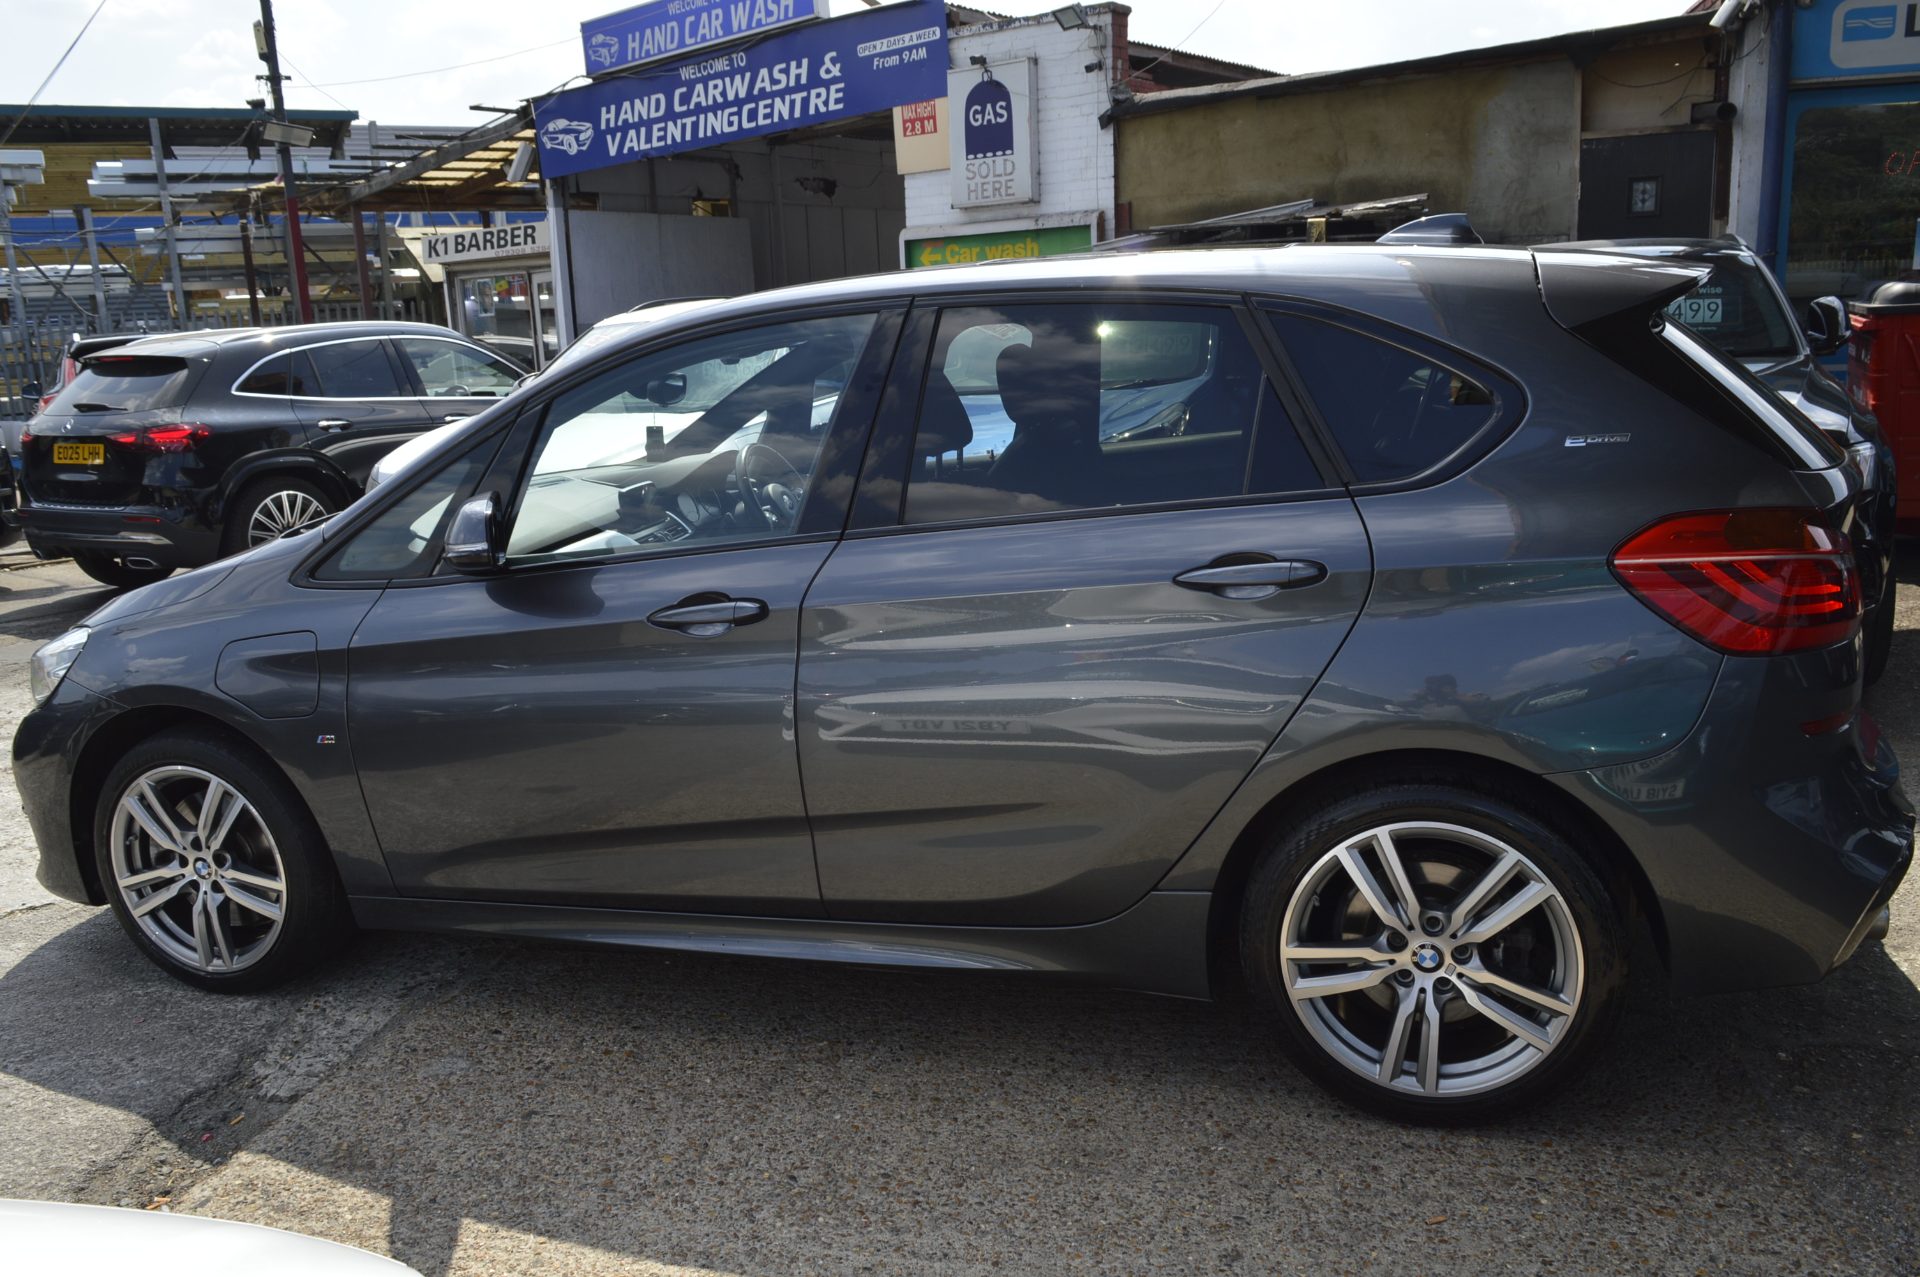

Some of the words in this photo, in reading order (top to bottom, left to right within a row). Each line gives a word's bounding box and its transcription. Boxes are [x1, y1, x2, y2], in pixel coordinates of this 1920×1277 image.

[627, 22, 679, 61] HAND
[685, 8, 723, 45] CAR
[732, 0, 795, 33] WASH
[858, 44, 877, 55] OPEN
[879, 41, 884, 50] 7
[886, 35, 906, 48] DAYS
[908, 35, 914, 43] A
[915, 28, 937, 42] WEEK
[679, 61, 730, 81] WELCOME
[733, 51, 746, 67] TO
[873, 55, 900, 70] From
[902, 46, 927, 63] 9AM
[601, 93, 666, 130] HAND
[819, 51, 842, 80] &
[902, 104, 917, 120] MAX
[917, 101, 936, 117] HIGHT
[969, 101, 1008, 127] GAS
[905, 121, 922, 136] 2.8
[924, 119, 935, 133] M
[965, 160, 1016, 181] SOLD
[967, 179, 1016, 201] HERE
[427, 237, 449, 259] K1
[454, 225, 537, 254] BARBER
[945, 244, 981, 264] Car
[985, 238, 1040, 259] wash
